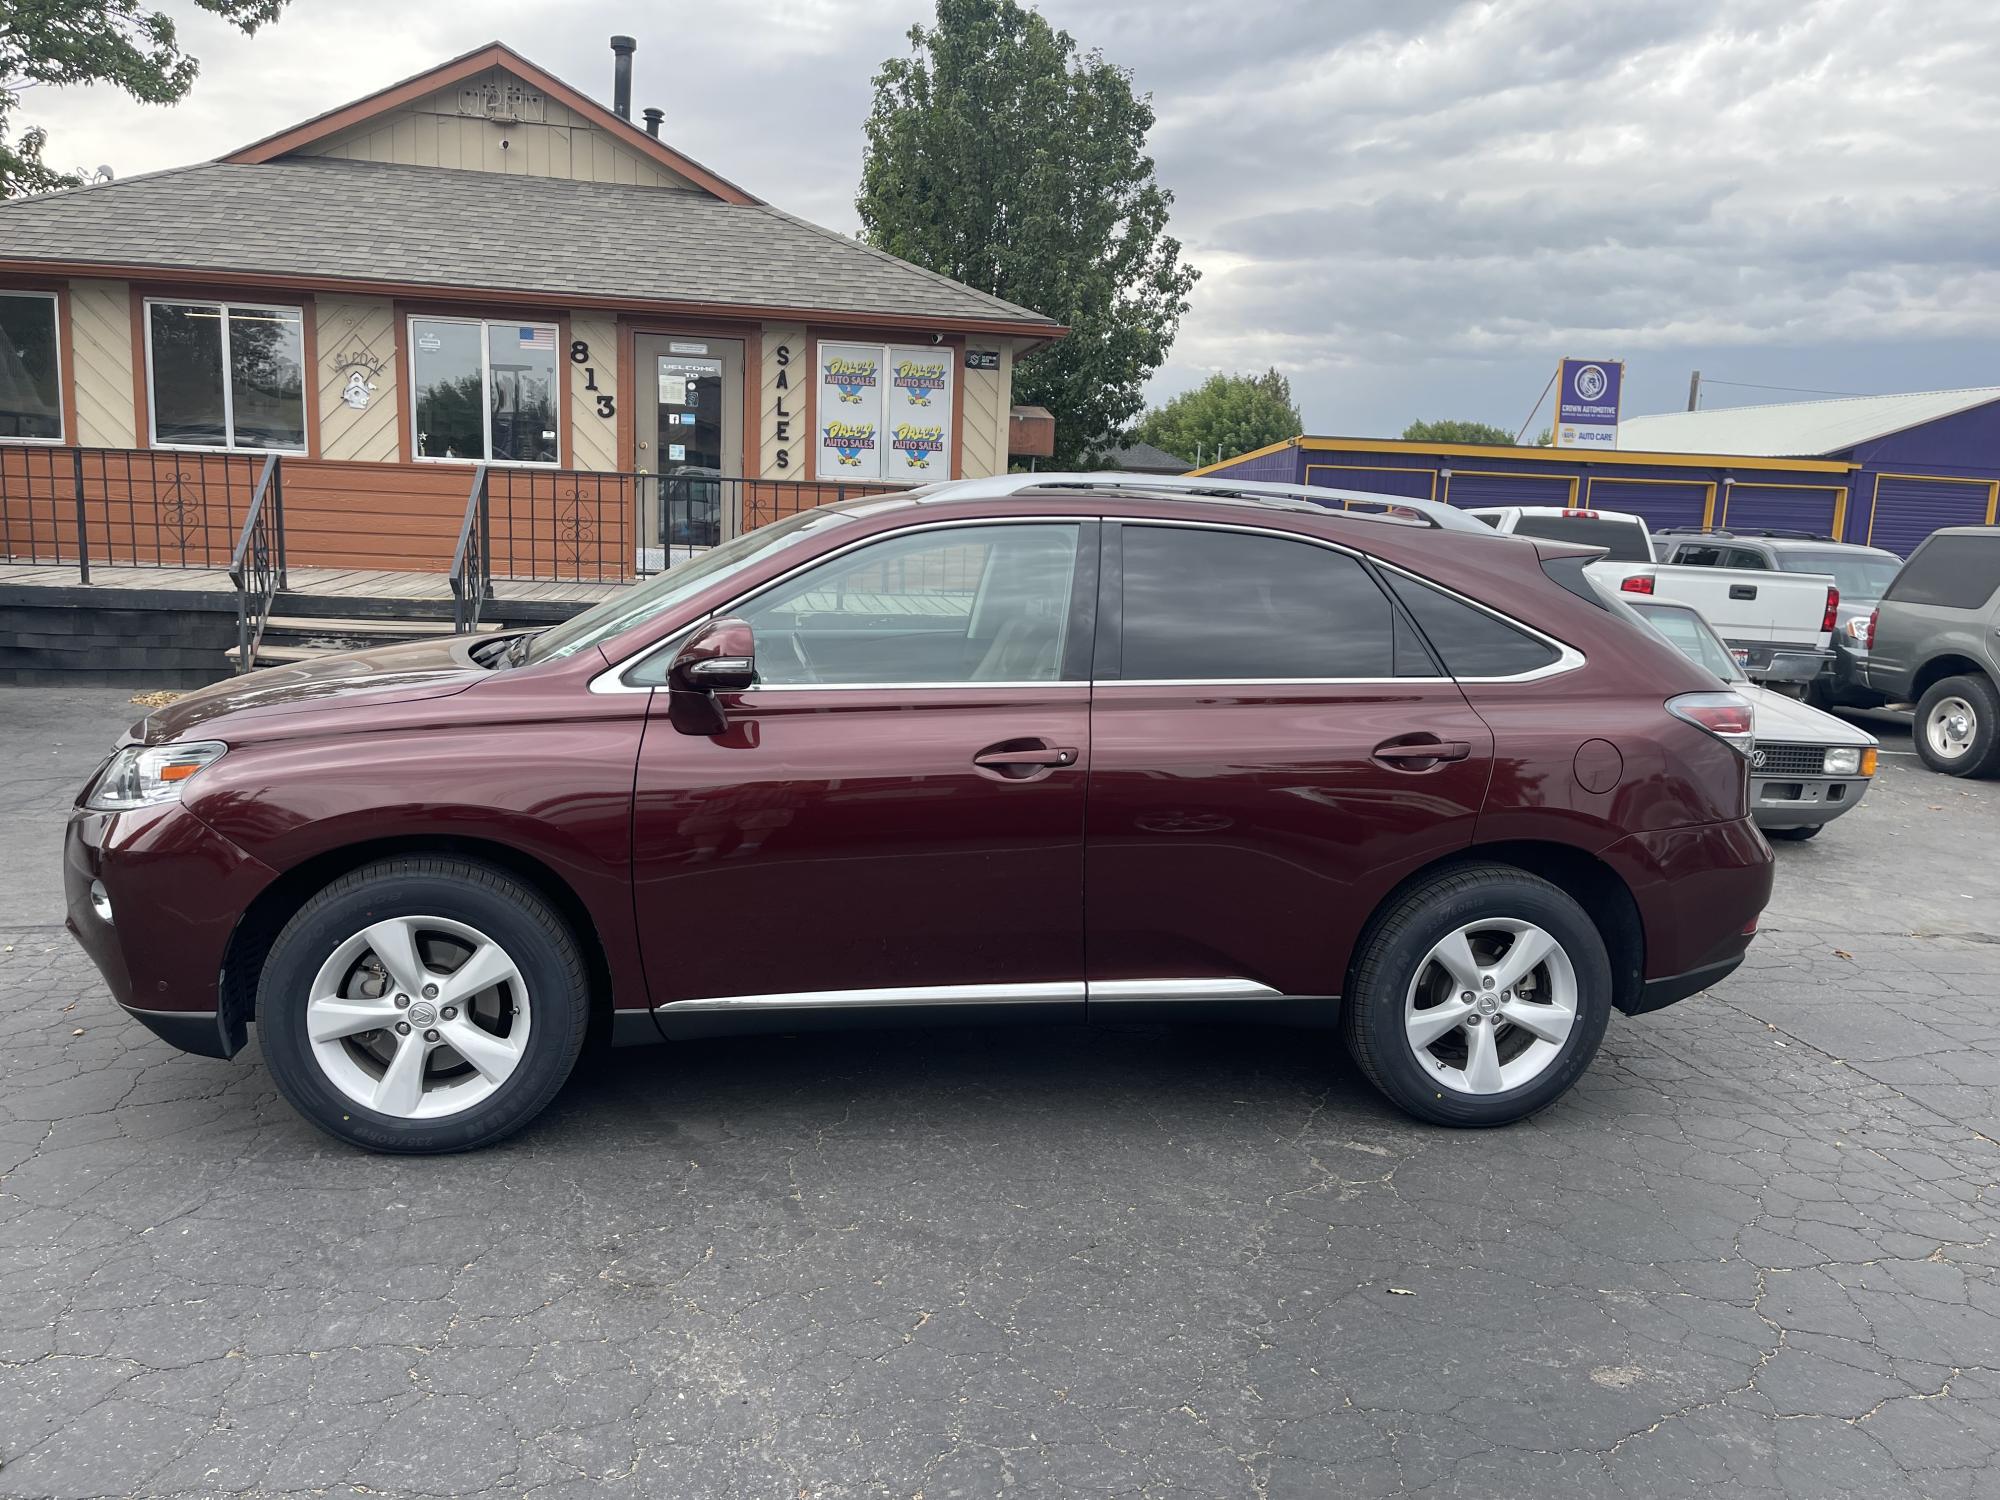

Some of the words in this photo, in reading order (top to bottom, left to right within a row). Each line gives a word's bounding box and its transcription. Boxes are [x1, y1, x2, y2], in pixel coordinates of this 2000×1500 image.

[327, 351, 387, 376] WELCOME
[826, 375, 849, 385] AUTO
[851, 377, 875, 386] SALES
[895, 378, 918, 388] AUTO
[920, 380, 944, 389] SALES
[776, 345, 790, 469] SALES
[1562, 404, 1582, 412] CROWN
[1579, 432, 1595, 440] AUTO
[1596, 433, 1613, 441] CARE
[825, 438, 848, 447] AUTO
[850, 440, 874, 449] SALES
[894, 440, 917, 450] AUTO
[918, 442, 942, 451] SALES
